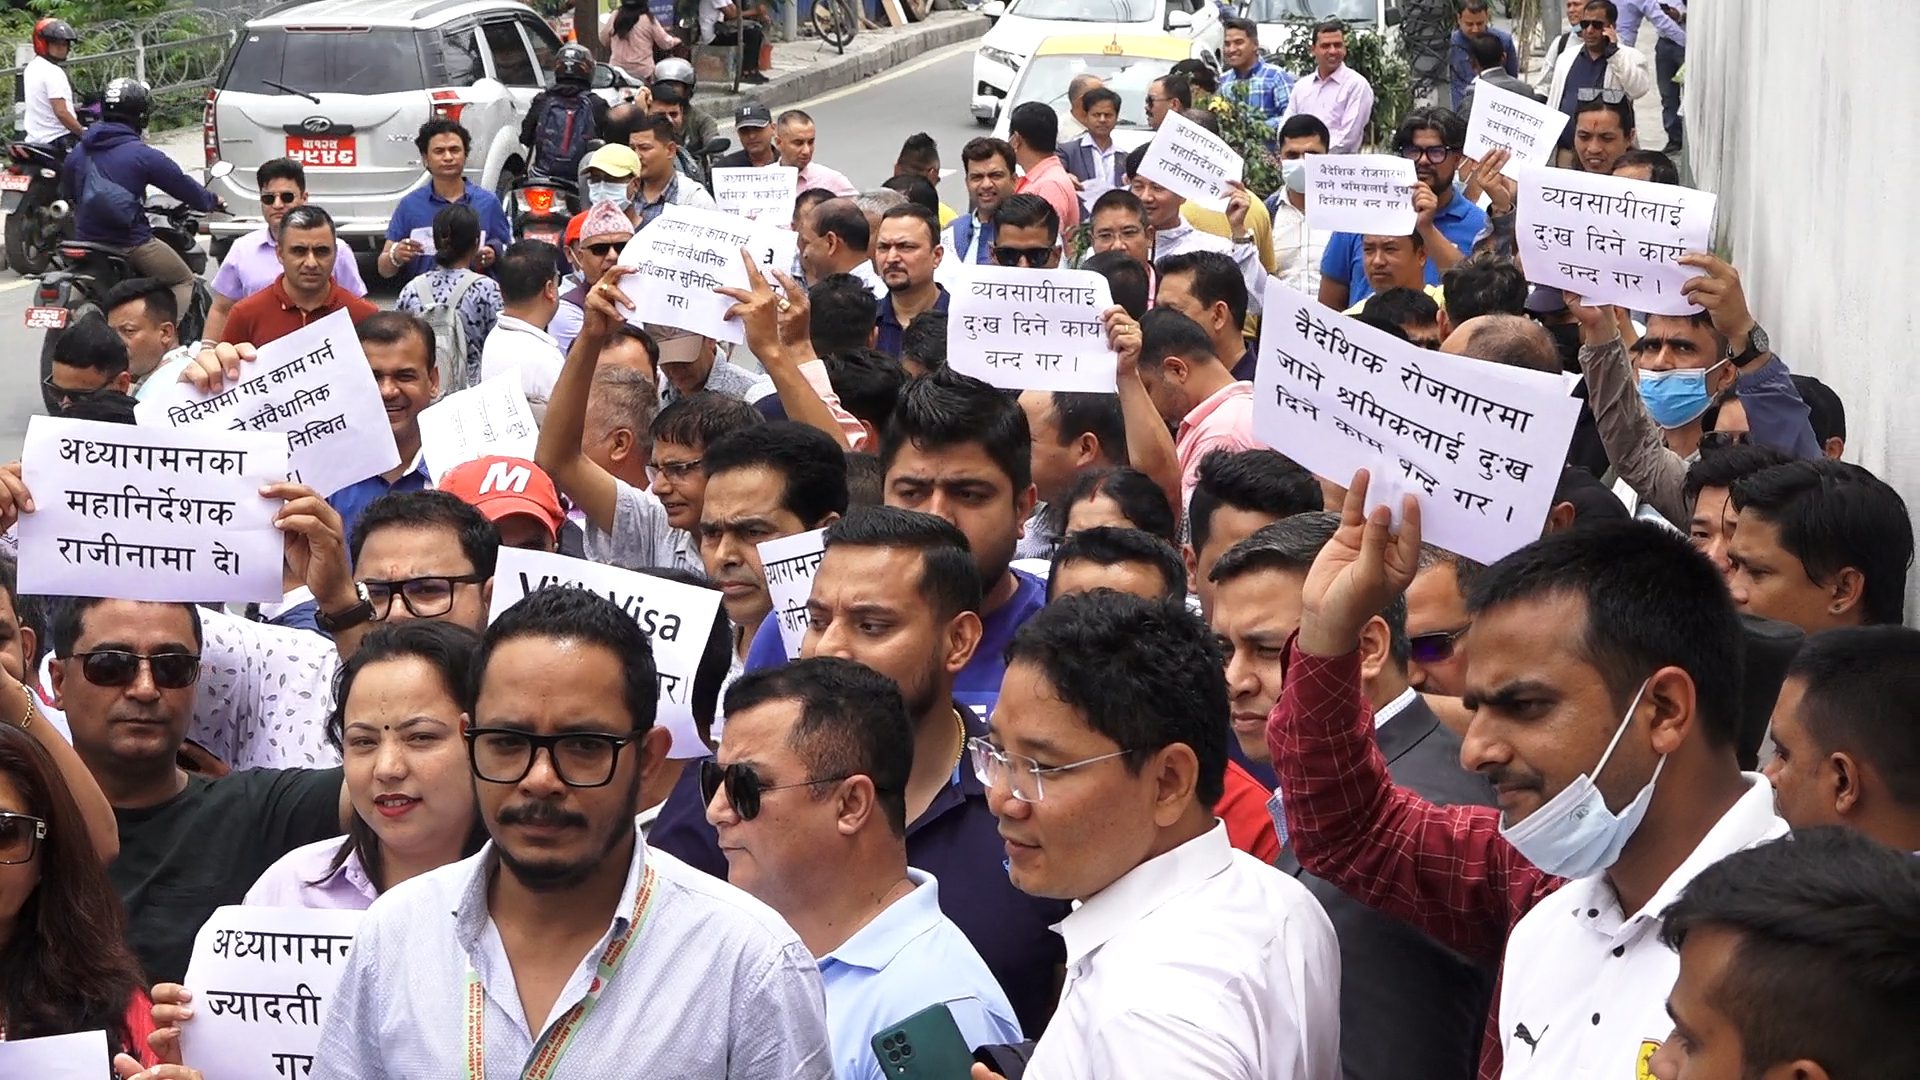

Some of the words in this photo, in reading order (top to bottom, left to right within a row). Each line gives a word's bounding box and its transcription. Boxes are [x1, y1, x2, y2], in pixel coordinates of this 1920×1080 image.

[1159, 158, 1206, 189] राजीनामा
[1541, 187, 1686, 228] व्यवसायीलाई
[706, 227, 728, 242] काम
[1586, 225, 1626, 255] दिने
[1638, 239, 1686, 263] कार्य
[637, 260, 677, 281] अधिकार
[1612, 271, 1643, 292] गर
[971, 280, 1096, 308] व्यवसायीलाई
[1013, 312, 1049, 336] दिने
[1060, 316, 1102, 338] कार्य
[1035, 354, 1063, 371] गर
[1294, 308, 1387, 374] वैदेशिक
[1400, 363, 1534, 433] रोजगारमा
[168, 389, 238, 427] विदेशमा
[268, 361, 307, 384] काम
[307, 339, 335, 365] गर्न
[249, 383, 330, 430] संवैधानिक
[1277, 348, 1325, 391] जाने
[1337, 385, 1465, 464] श्रमिकलाई
[59, 437, 247, 476] अध्यागमनका
[1276, 385, 1320, 421] दिने
[1454, 488, 1493, 516] गर
[479, 462, 531, 494] M
[64, 484, 235, 526] महानिर्देशक
[57, 533, 195, 572] राजीनामा
[206, 983, 322, 1026] ज्यादती
[543, 1026, 571, 1069] ASSOCIATION
